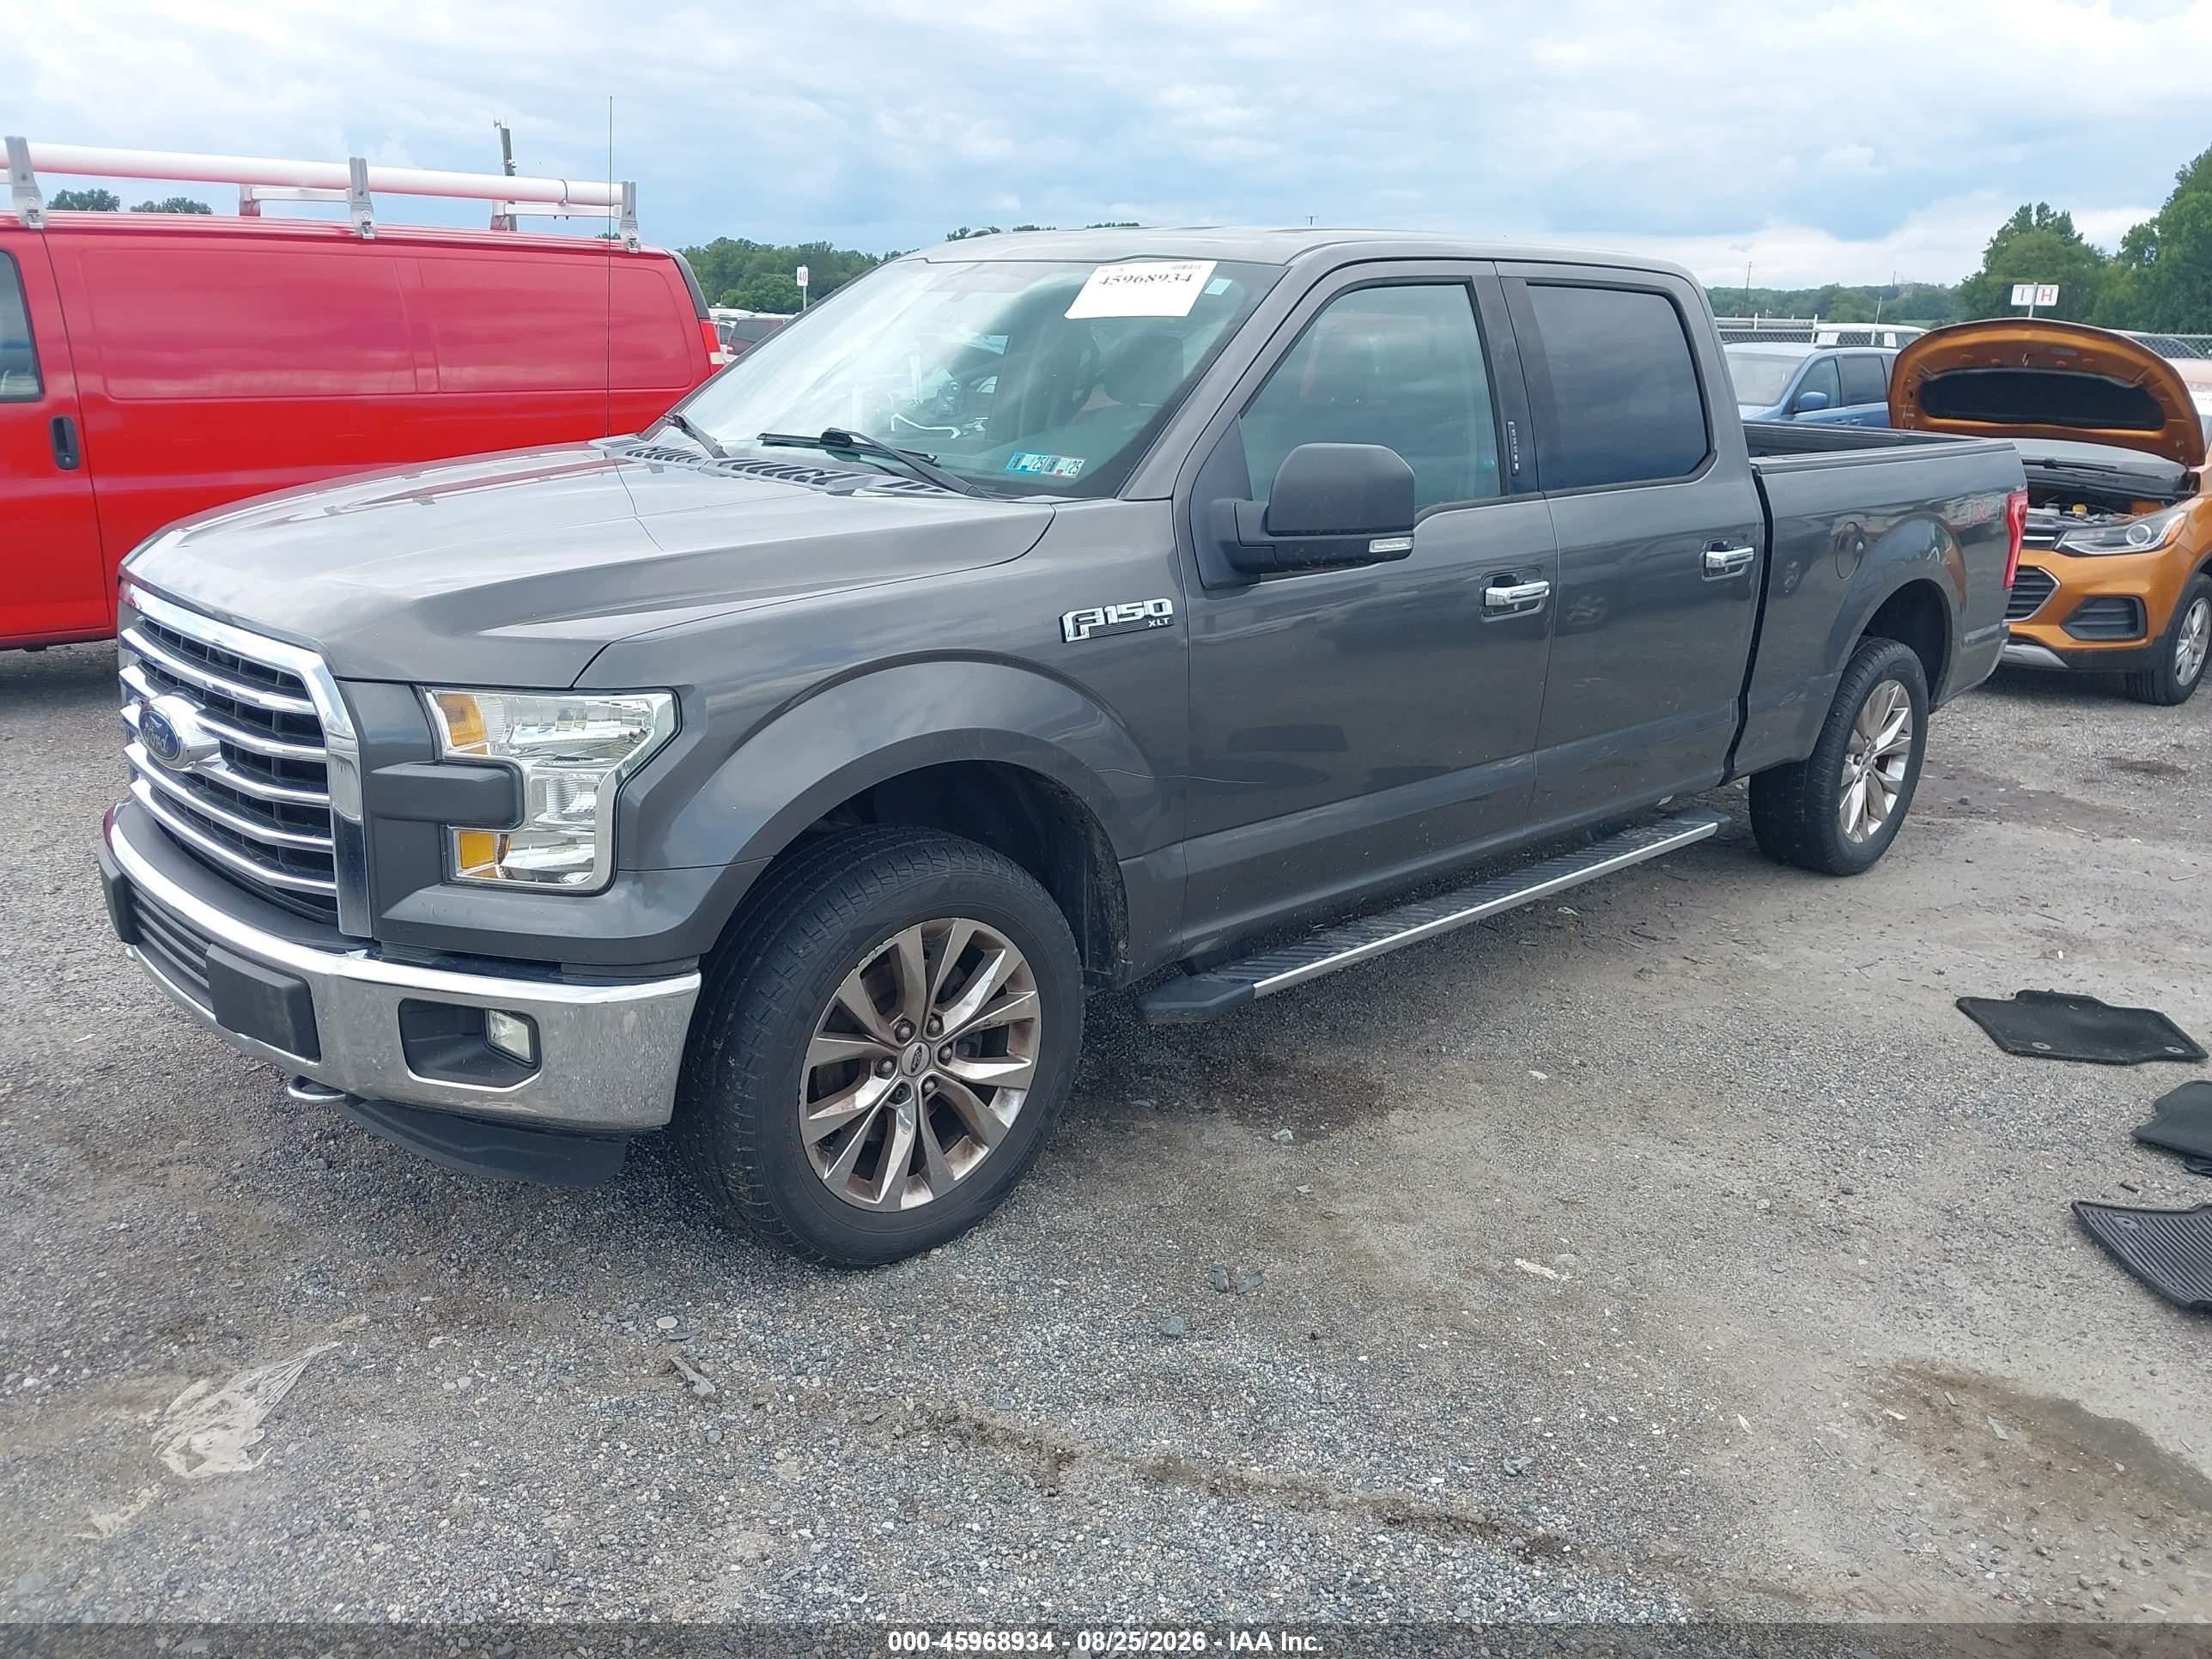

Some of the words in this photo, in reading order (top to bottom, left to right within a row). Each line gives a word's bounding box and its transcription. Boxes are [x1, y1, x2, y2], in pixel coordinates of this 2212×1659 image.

[798, 270, 807, 283] 40
[1099, 273, 1194, 285] 45968934
[2040, 288, 2053, 301] H
[1148, 617, 1170, 628] XLT
[143, 715, 169, 753] Ford
